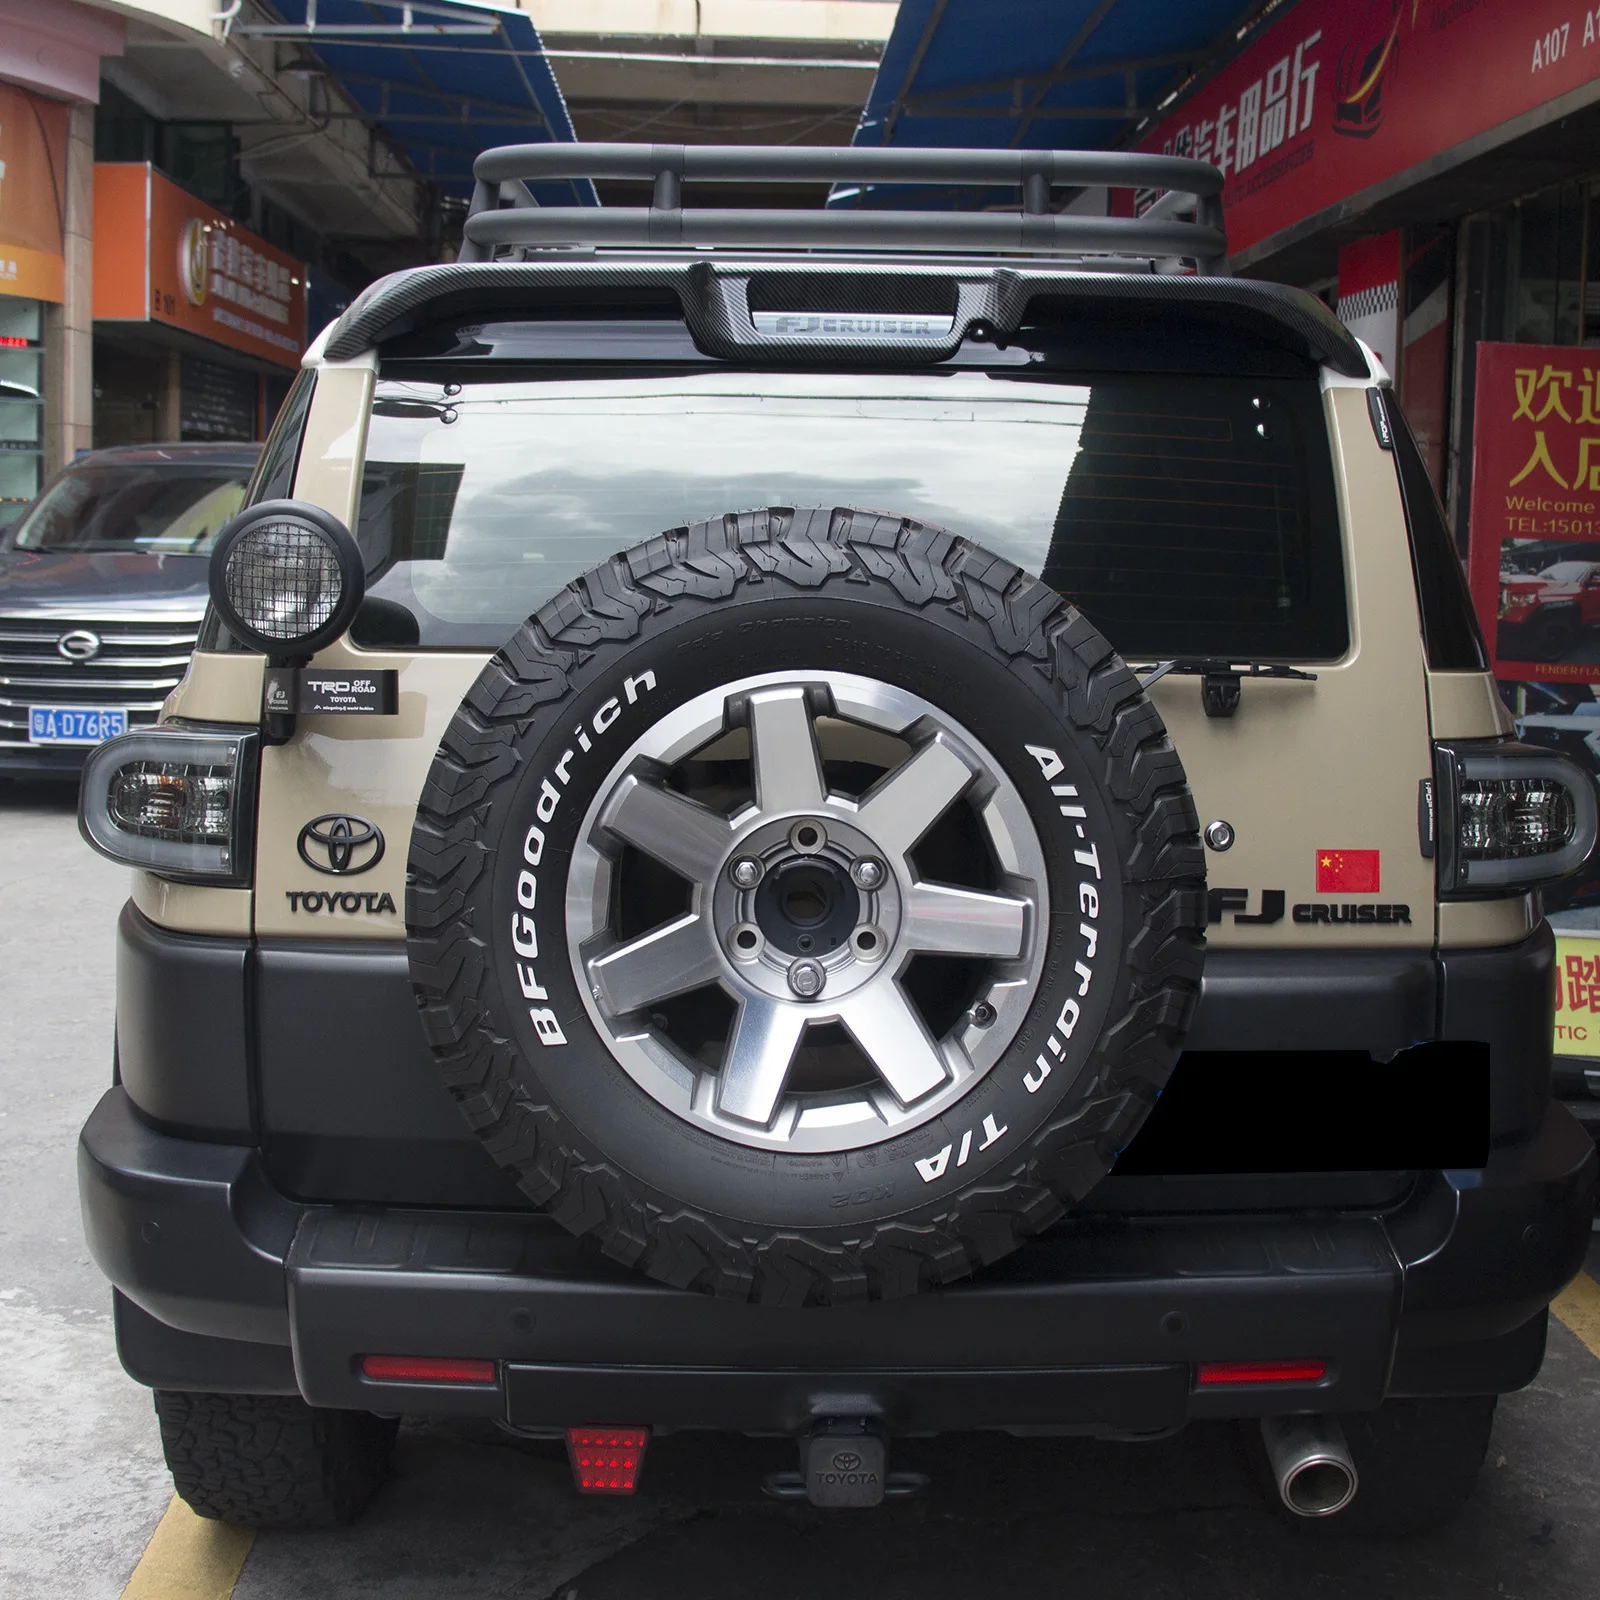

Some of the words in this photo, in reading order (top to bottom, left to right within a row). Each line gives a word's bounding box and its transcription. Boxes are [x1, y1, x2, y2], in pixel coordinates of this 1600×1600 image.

[1531, 22, 1570, 73] A107
[775, 317, 821, 333] FJ
[822, 319, 931, 335] CRUISER
[1505, 496, 1595, 514] Welcome
[1535, 664, 1578, 676] FENDER
[307, 681, 350, 694] TRD
[511, 670, 657, 1046] BFGoodrich
[286, 891, 397, 914] TOYOTA
[1207, 888, 1286, 924] FJ
[1292, 904, 1412, 924] CRUISER
[1022, 744, 1102, 1093] All-Terrain
[914, 1113, 1009, 1184] T/A
[815, 1472, 878, 1485] TOYOTA
